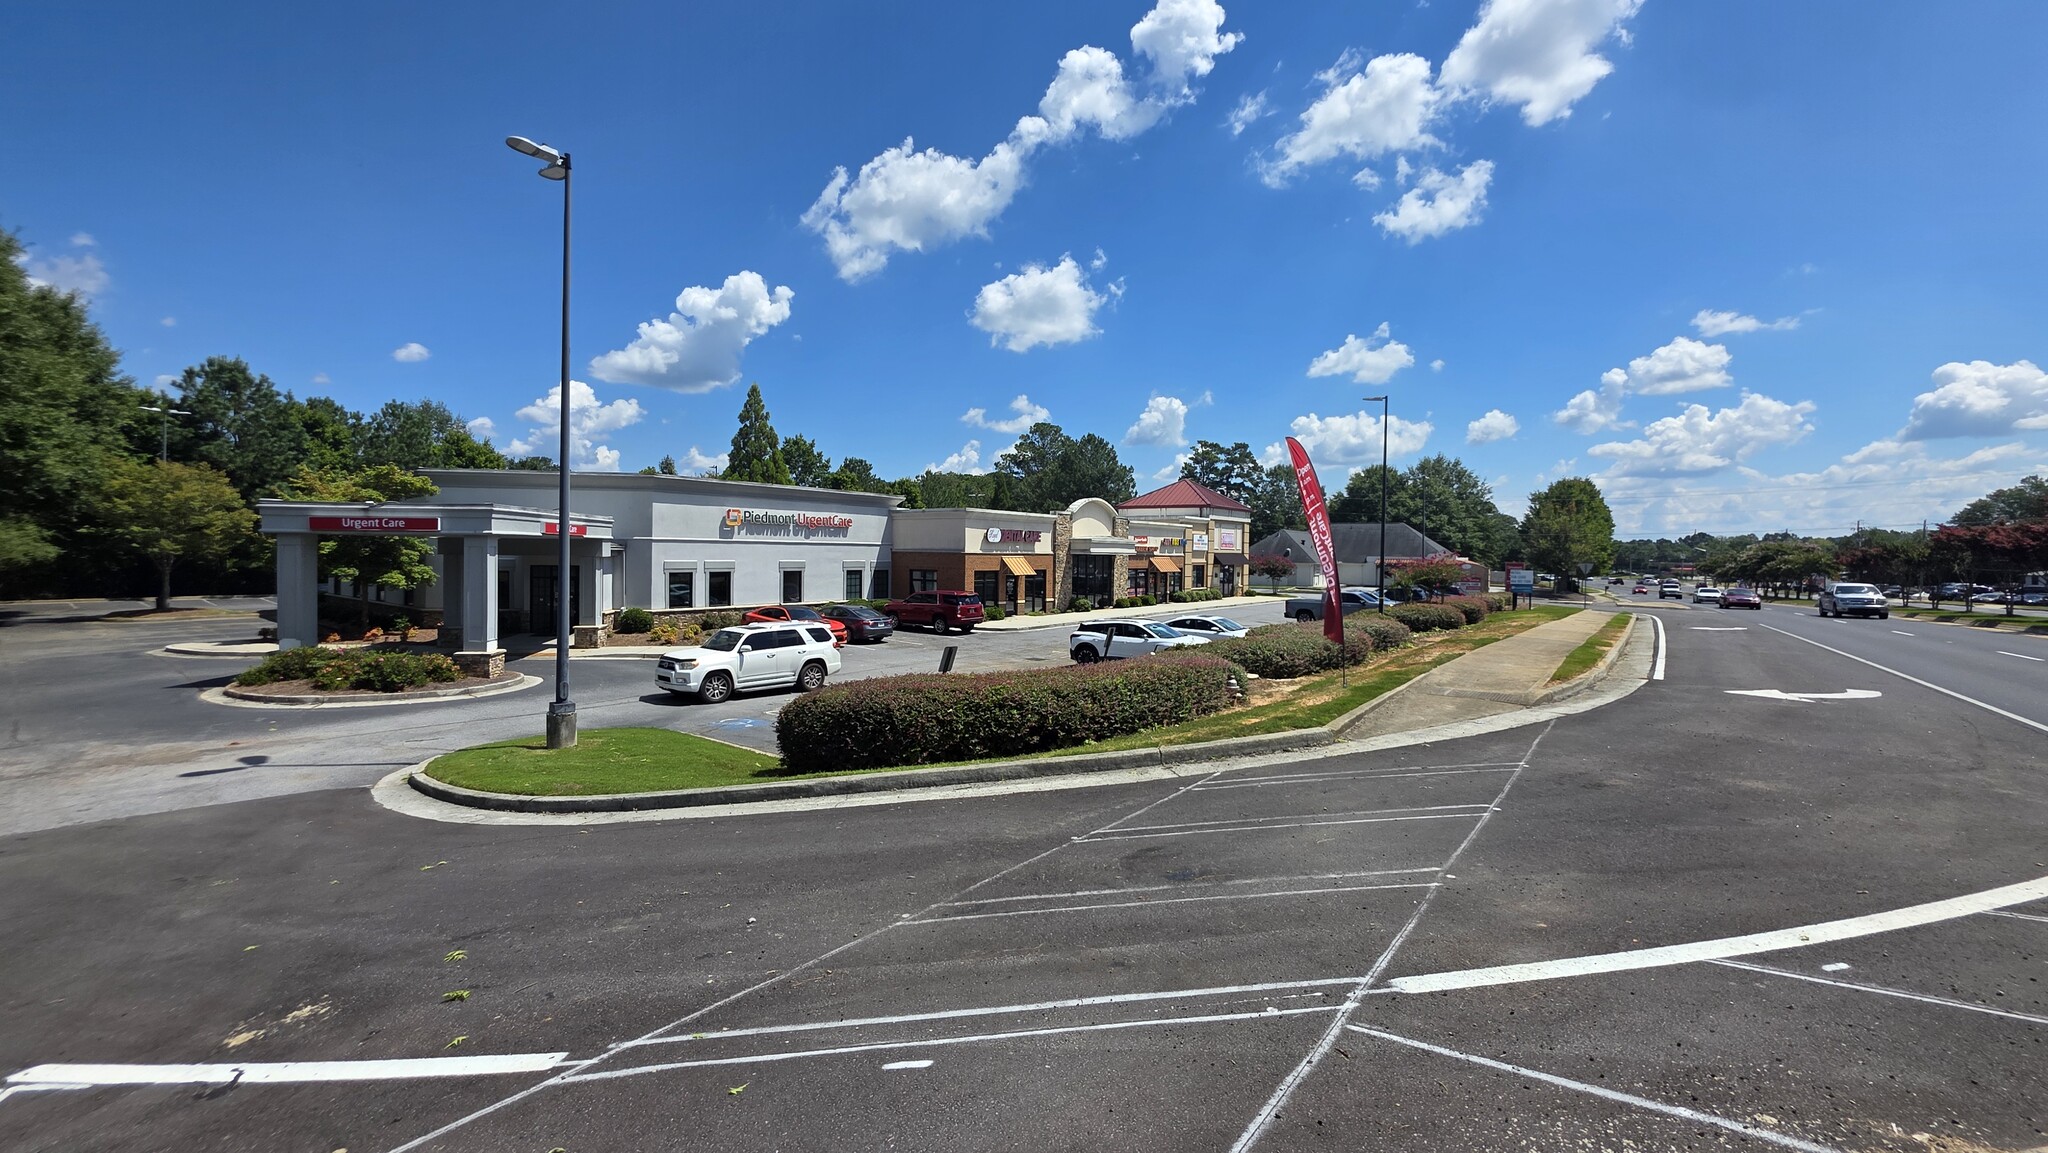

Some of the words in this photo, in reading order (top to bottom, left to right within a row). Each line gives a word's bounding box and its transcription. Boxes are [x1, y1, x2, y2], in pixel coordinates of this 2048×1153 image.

[342, 518, 379, 529] Urgent
[382, 518, 405, 528] Care
[743, 510, 796, 525] Piedmont
[797, 513, 853, 529] UrgentCare
[1026, 531, 1042, 544] CARE
[1309, 516, 1335, 588] Piedmont
